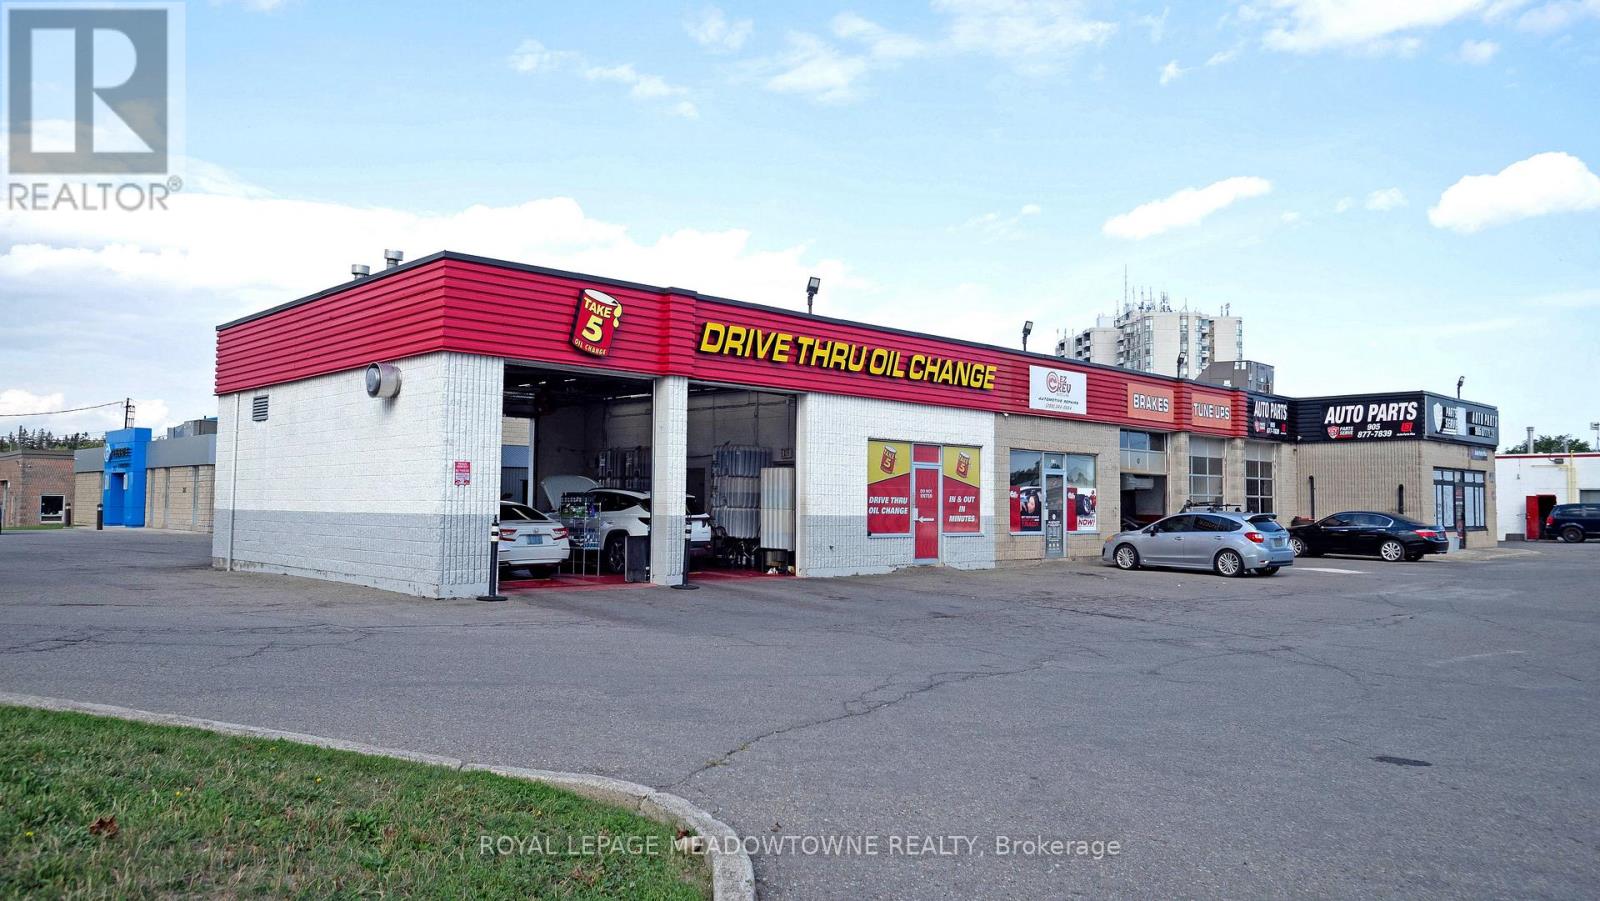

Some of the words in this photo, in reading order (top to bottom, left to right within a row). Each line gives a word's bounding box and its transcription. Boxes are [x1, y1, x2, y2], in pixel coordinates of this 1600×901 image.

[583, 296, 612, 319] TAKE
[581, 315, 603, 342] 5
[700, 321, 793, 363] DRIVE
[797, 336, 868, 372] THRU
[869, 349, 905, 378] OIL
[909, 354, 998, 390] CHANGE
[1133, 393, 1169, 413] BRAKES
[1192, 403, 1214, 418] TUNE
[1215, 406, 1230, 420] UPS
[1253, 400, 1270, 418] AUTO
[1270, 402, 1288, 420] PARTS
[1324, 404, 1364, 424] AUTO
[1367, 402, 1418, 422] PARTS
[1366, 423, 1381, 431] 905
[883, 458, 891, 468] 5
[959, 464, 966, 473] 5
[868, 496, 889, 504] DRIVE
[890, 496, 908, 504] THRU
[948, 495, 956, 503] IN
[957, 495, 963, 503] &
[868, 506, 880, 515] OIL
[881, 506, 909, 515] CHANGE
[958, 505, 966, 513] IN
